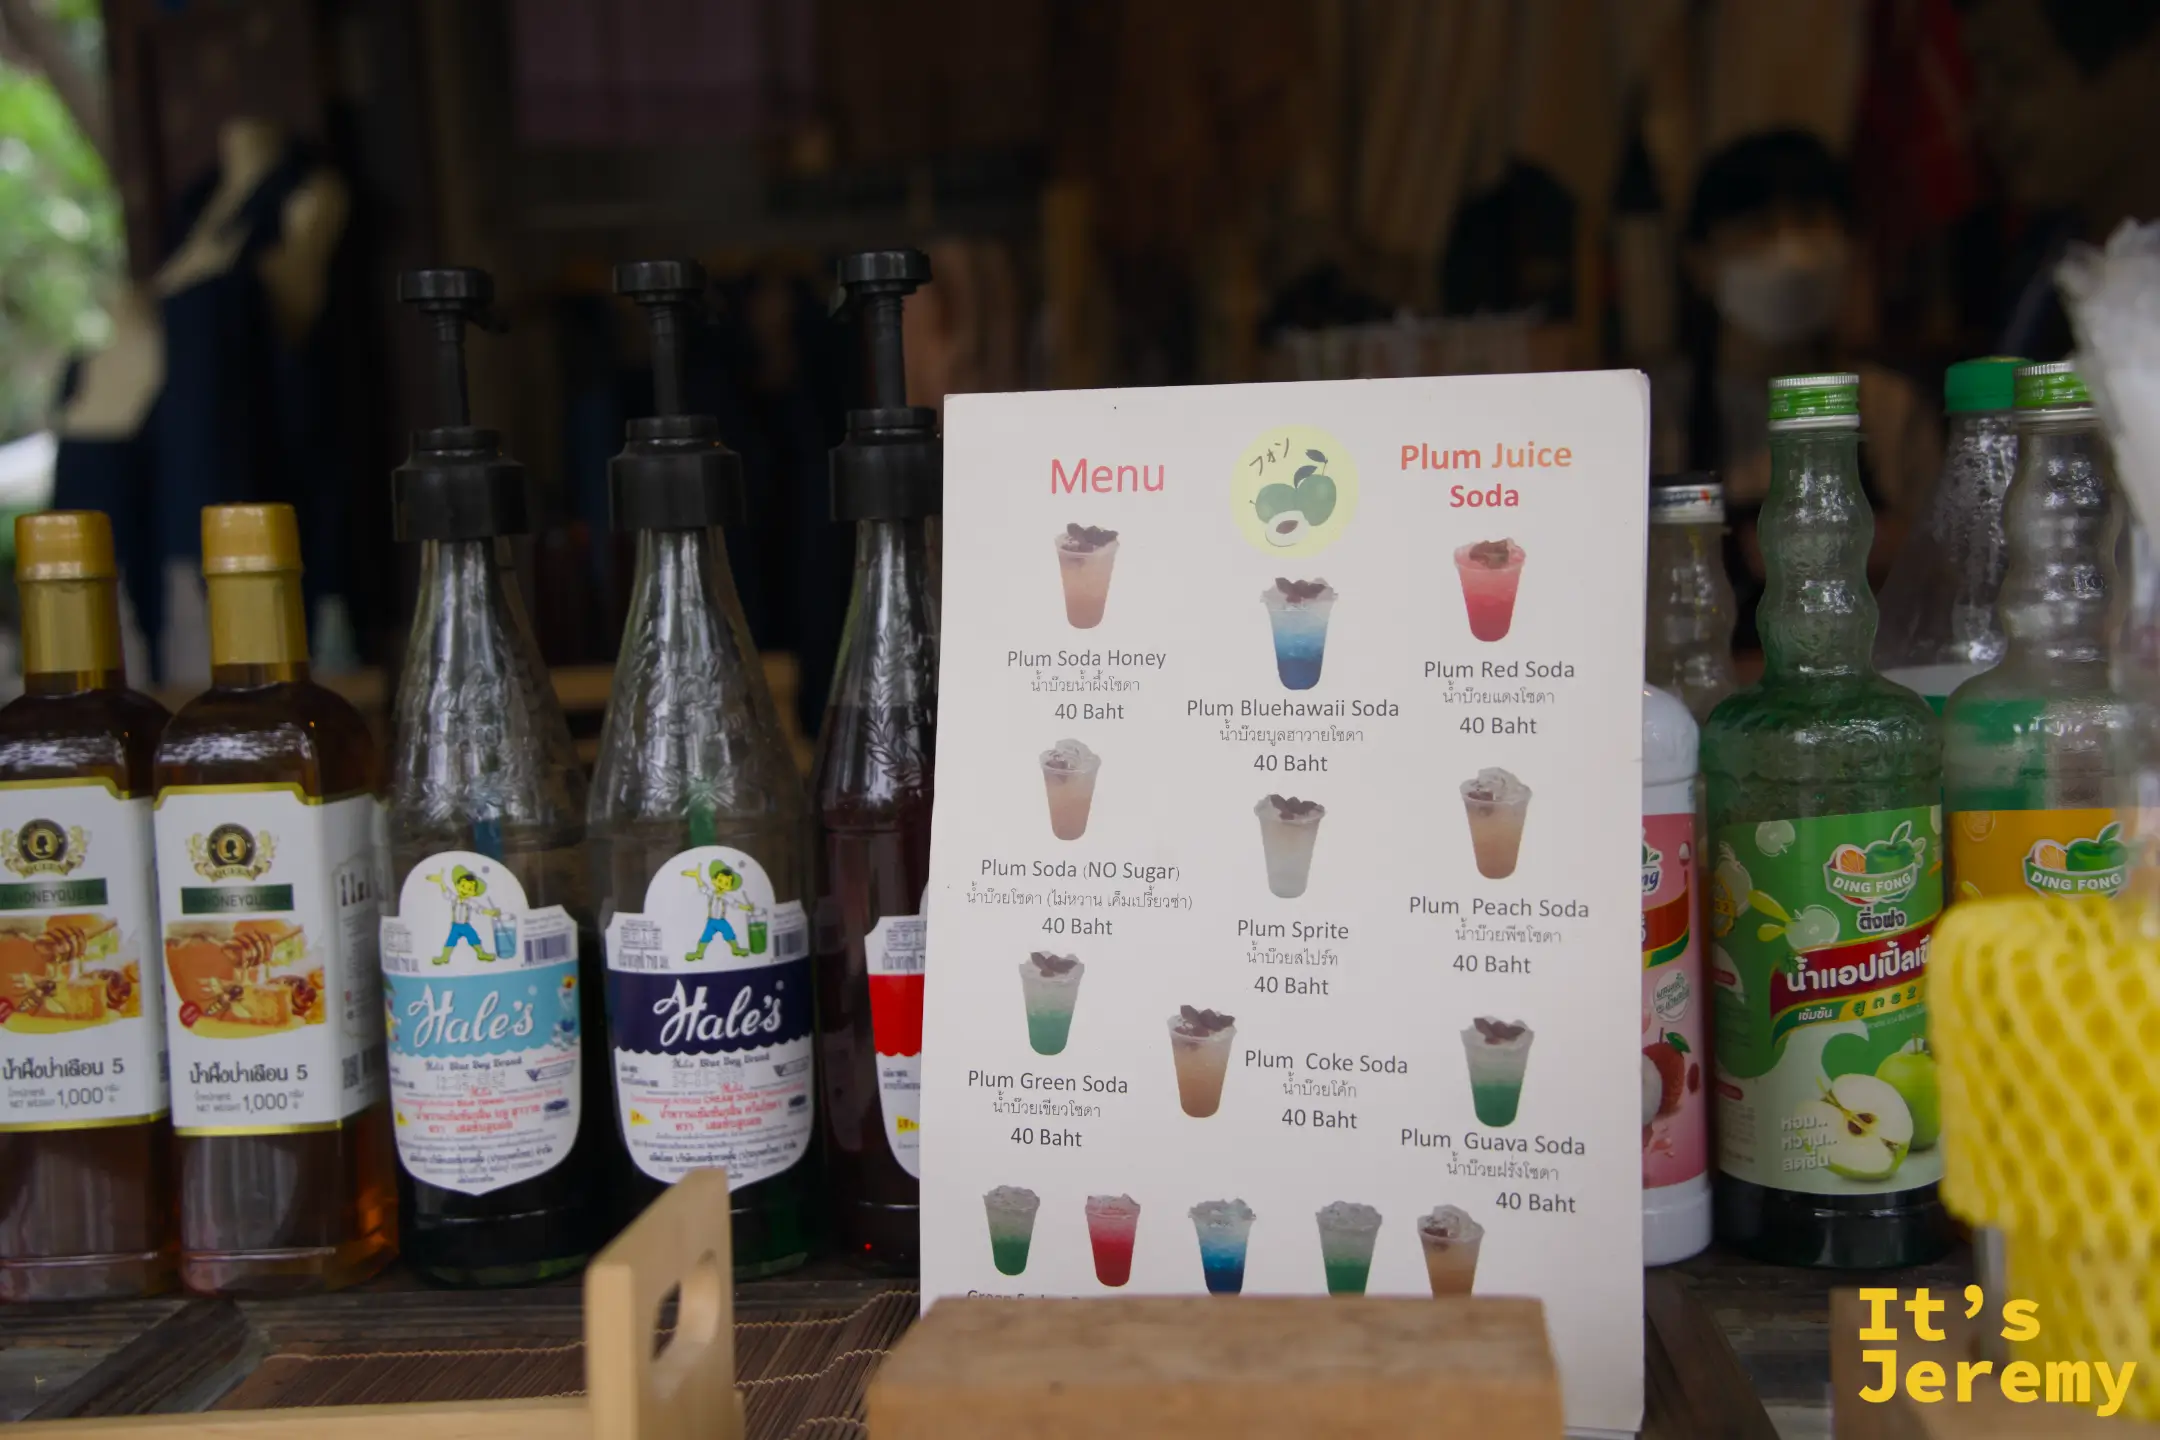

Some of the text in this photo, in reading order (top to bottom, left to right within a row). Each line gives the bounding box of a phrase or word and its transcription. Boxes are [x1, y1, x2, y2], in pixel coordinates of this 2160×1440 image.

[1401, 441, 1572, 470] Plum Juice
[1051, 458, 1165, 494] Menu
[1450, 484, 1519, 507] Soda
[1008, 650, 1167, 670] Plum Soda Honey
[1424, 660, 1575, 678] Plum Red Soda
[1054, 702, 1125, 720] 40 Baht
[1187, 699, 1399, 717] Plum Bluehawaii Soda
[1459, 716, 1537, 734] 40 Baht
[1253, 754, 1328, 772] 40 Baht
[981, 859, 1180, 883] Plum Soda (NO Sugar)
[2030, 871, 2122, 891] DING FONG
[966, 880, 1042, 905] น้ำบ๊วยโซดา
[1833, 872, 1911, 893] DING FONG
[1410, 896, 1589, 918] Plum Peach Soda
[1041, 917, 1113, 936] 40 Baht
[1237, 919, 1349, 943] Plum Sprite
[1452, 954, 1532, 974] 40 Baht
[1253, 976, 1329, 996] 40 Baht
[408, 983, 534, 1048] Hale's
[653, 979, 781, 1047] Hale's
[112, 1058, 125, 1075] 5
[1245, 1049, 1408, 1074] Plum Coke Soda
[296, 1064, 309, 1081] 5
[968, 1070, 1128, 1094] Plum Green Soda
[57, 1087, 104, 1108] 1,000
[243, 1093, 288, 1114] 1,000
[1281, 1108, 1358, 1129] 40 Baht
[1010, 1127, 1082, 1147] 40 Baht
[1401, 1128, 1586, 1155] Plum Guava Soda
[1495, 1191, 1576, 1214] 40 Baht
